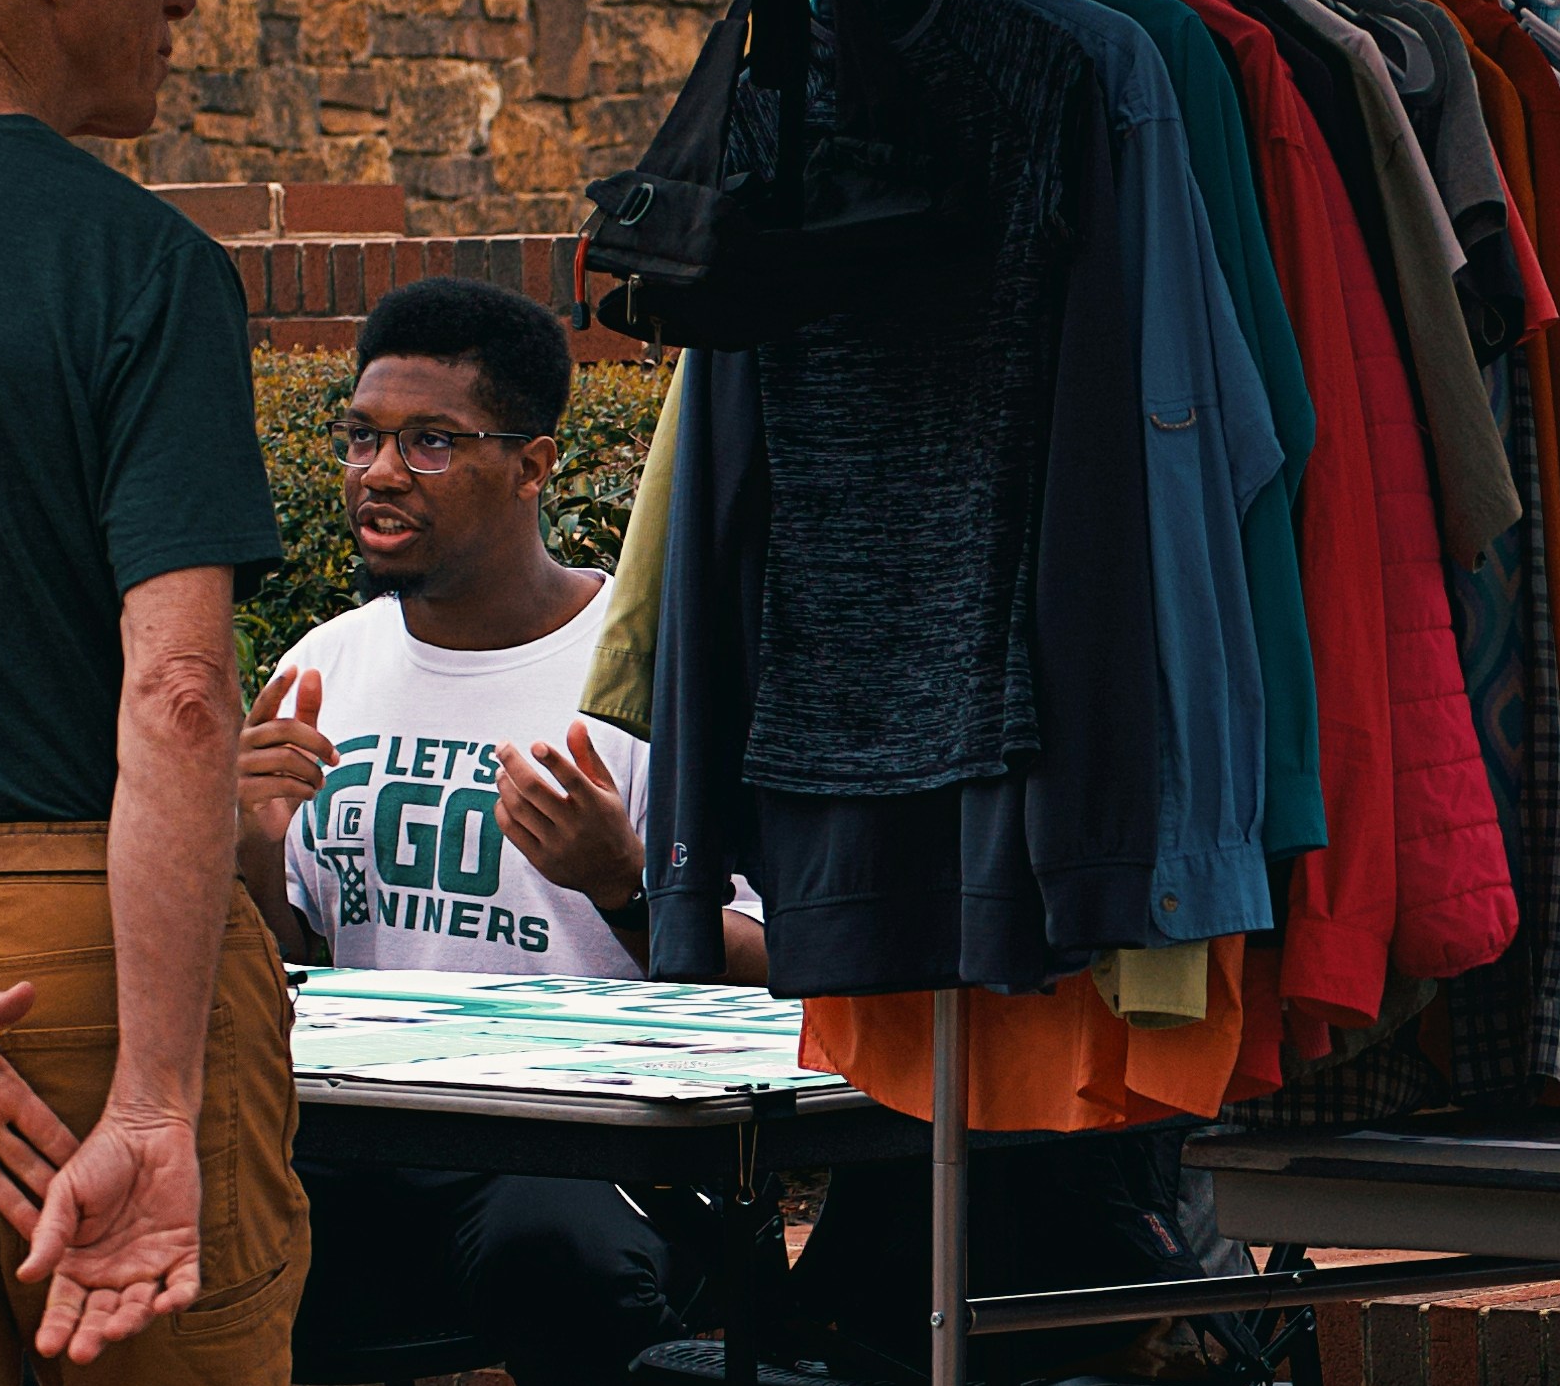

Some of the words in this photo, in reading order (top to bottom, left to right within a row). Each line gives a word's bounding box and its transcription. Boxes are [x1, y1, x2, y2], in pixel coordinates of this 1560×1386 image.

[384, 735, 501, 785] LET'S
[373, 781, 504, 897] GO
[377, 889, 549, 953] NINERS
